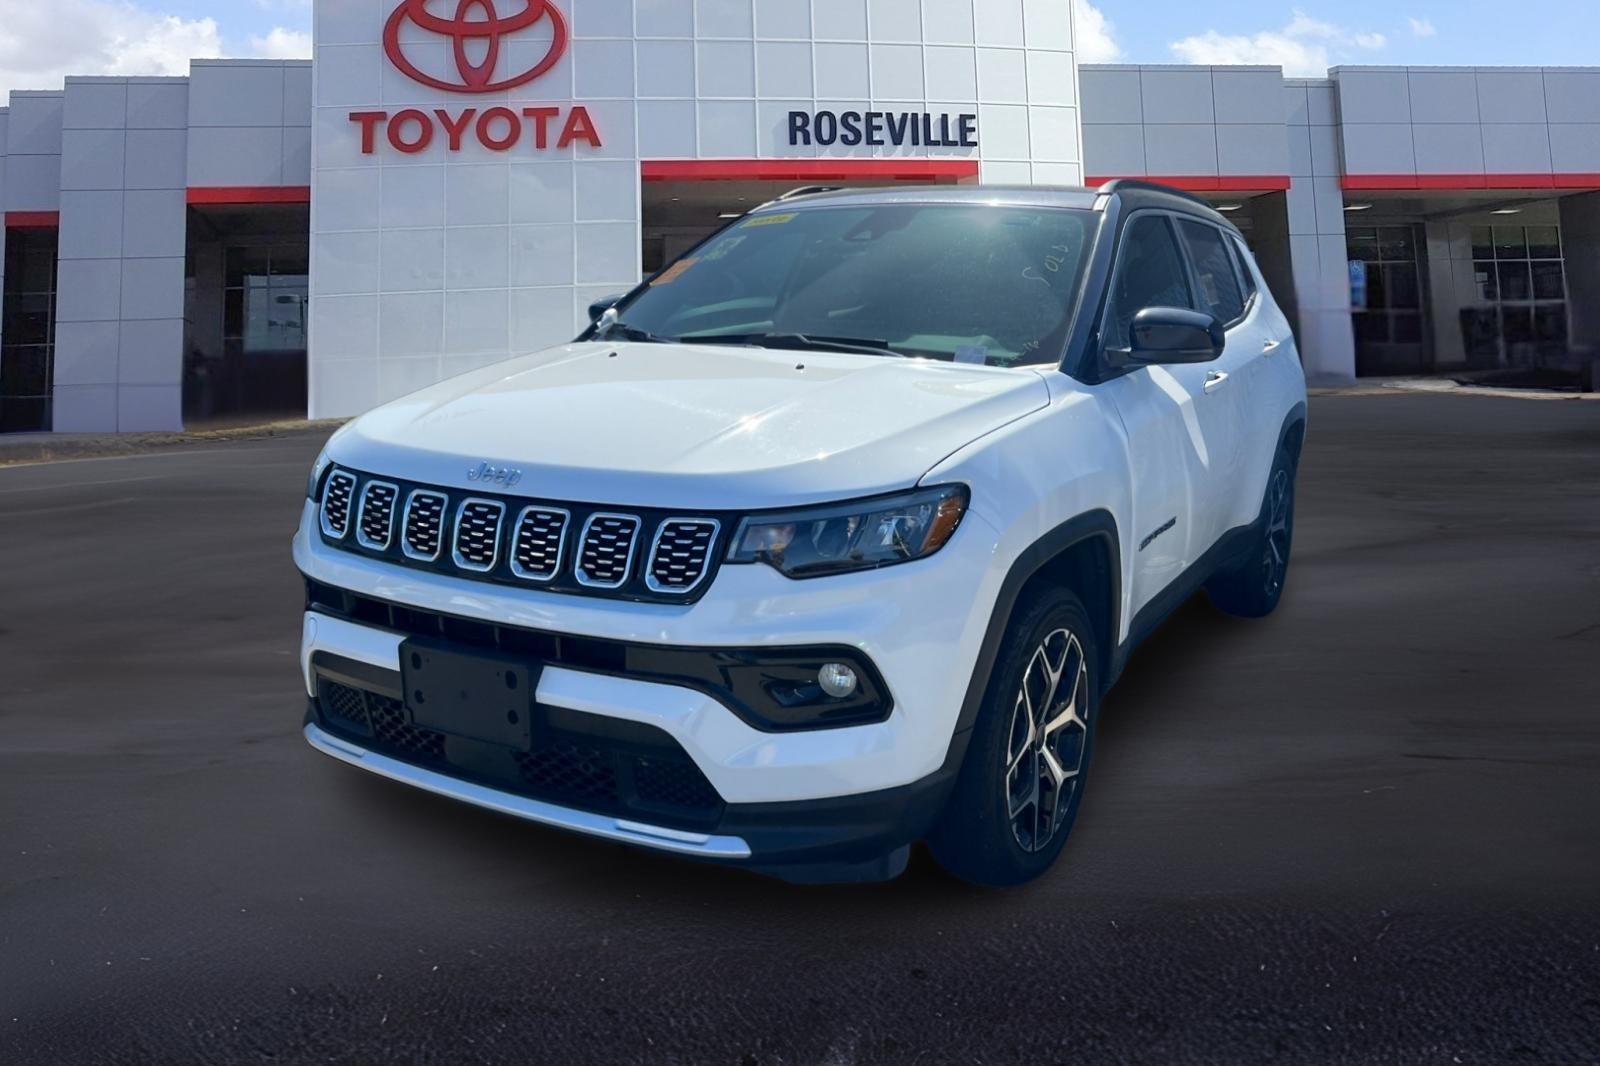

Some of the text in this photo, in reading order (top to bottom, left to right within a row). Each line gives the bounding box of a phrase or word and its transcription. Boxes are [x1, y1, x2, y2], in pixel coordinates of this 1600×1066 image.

[349, 106, 601, 154] TOYOTA
[788, 110, 978, 147] ROSEVILLE
[467, 458, 522, 489] Jeep
